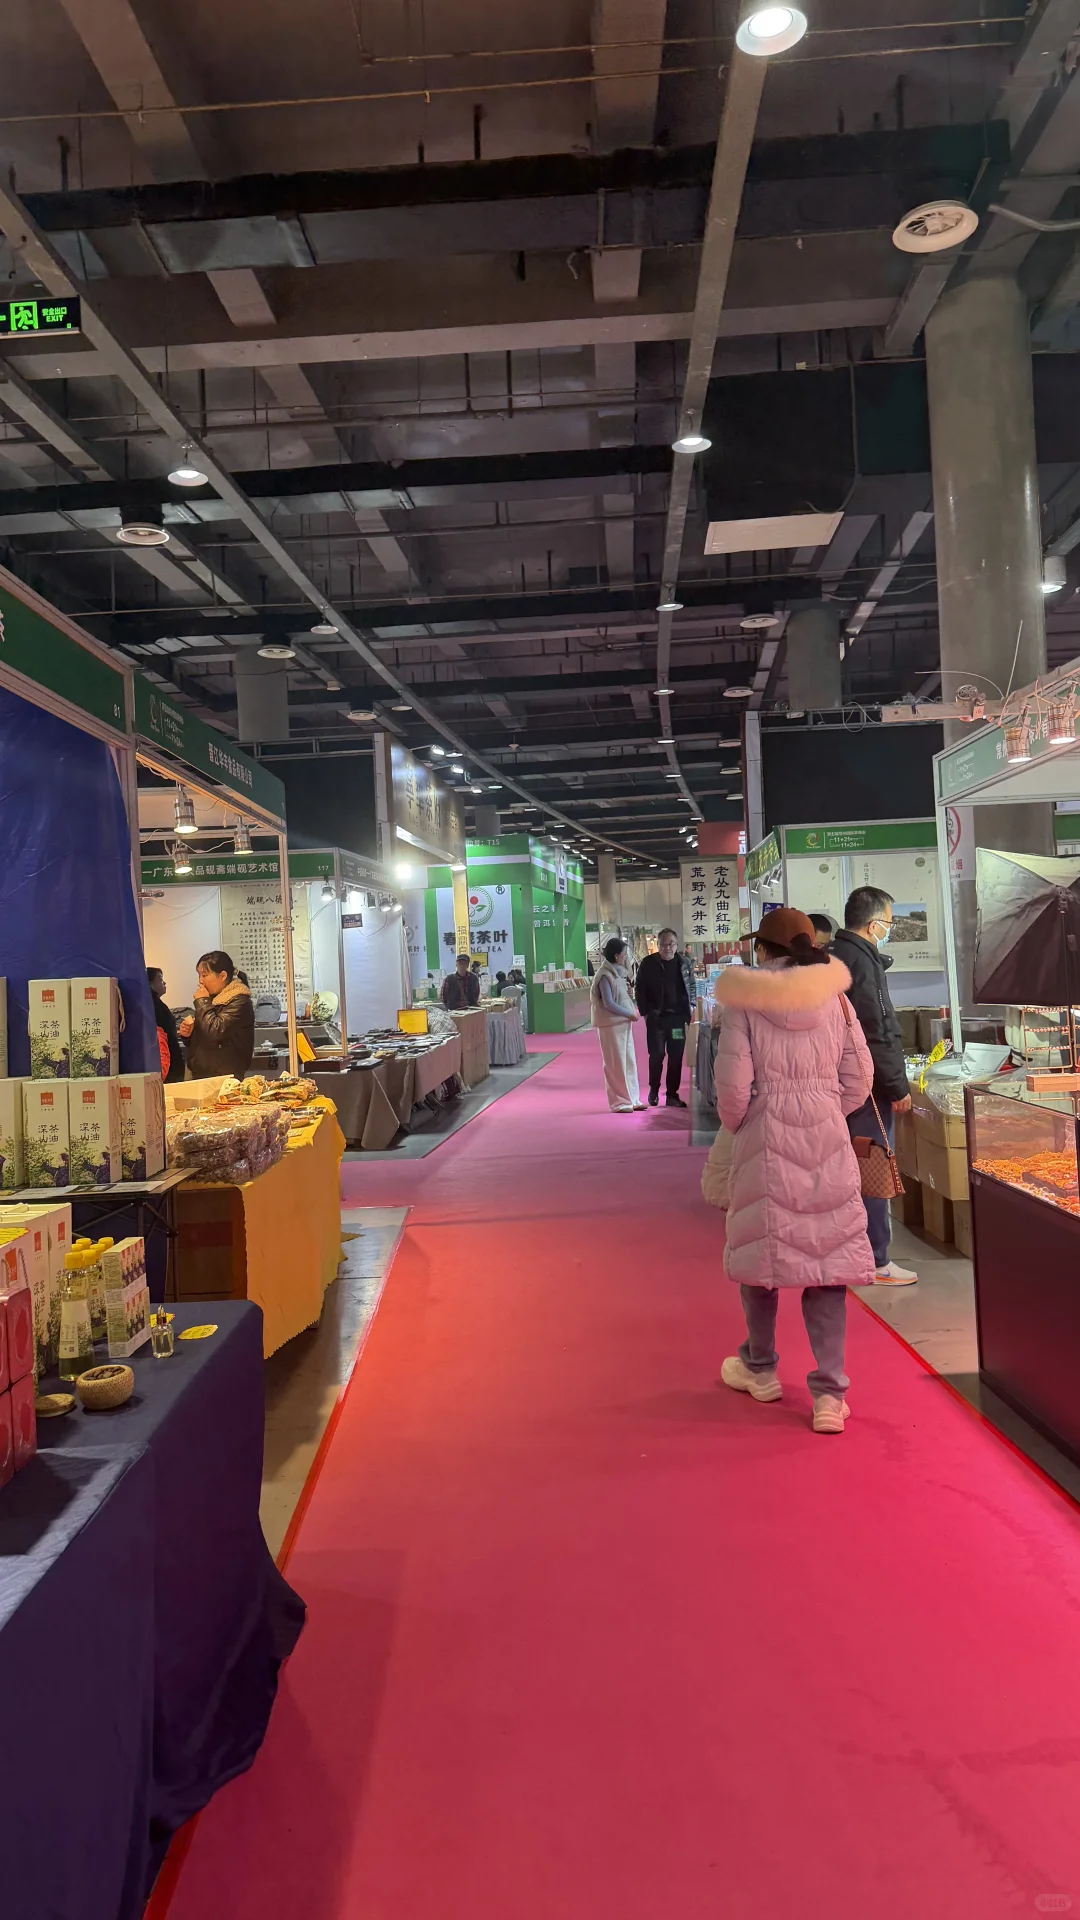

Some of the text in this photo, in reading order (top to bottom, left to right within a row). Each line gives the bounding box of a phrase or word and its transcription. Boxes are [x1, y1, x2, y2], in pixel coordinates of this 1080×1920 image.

[42, 307, 67, 316] 安全出口
[690, 866, 708, 936] 荒野龙井茶
[714, 865, 731, 935] 老丛九曲红梅
[450, 945, 503, 954] SNG TEA
[126, 1118, 137, 1136] 茶油
